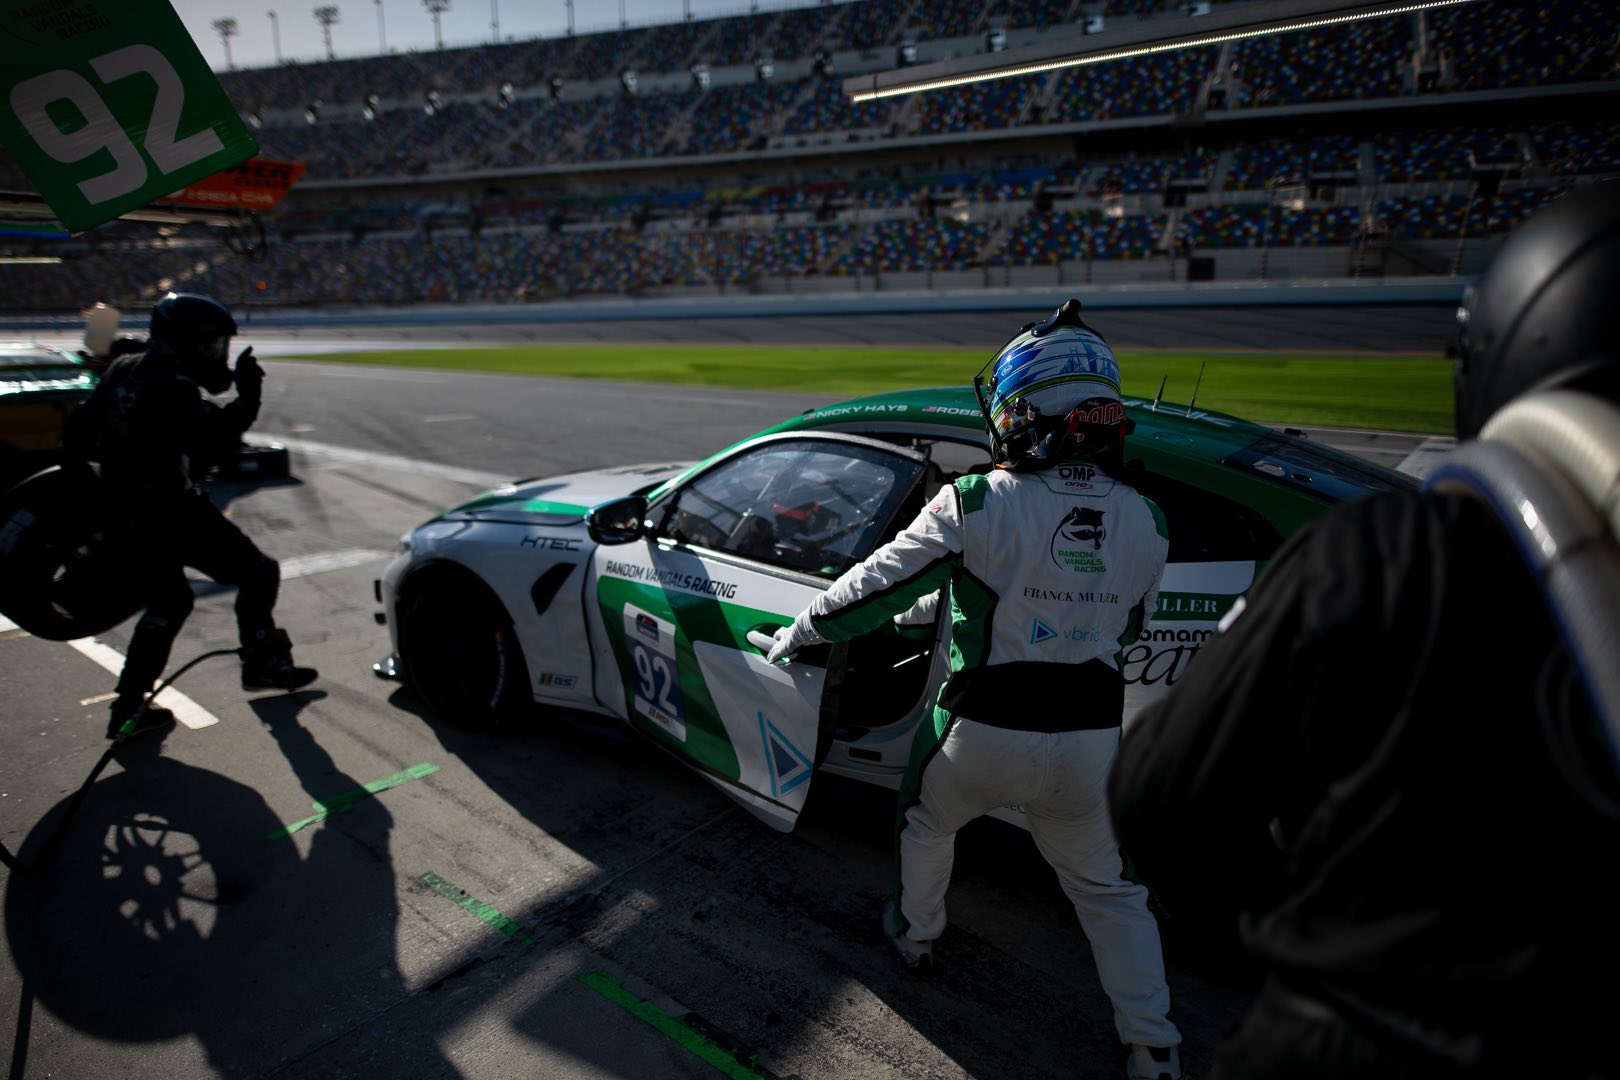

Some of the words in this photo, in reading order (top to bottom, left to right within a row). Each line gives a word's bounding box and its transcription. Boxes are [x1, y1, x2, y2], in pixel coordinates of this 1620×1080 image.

[9, 44, 225, 206] 92
[816, 405, 863, 419] NICKY
[864, 404, 909, 413] HAYS
[1059, 466, 1095, 481] OMP
[520, 536, 583, 551] HTEC
[1058, 550, 1093, 558] RANDOM
[1064, 558, 1103, 566] VANDALS
[606, 560, 644, 580] RANDOM
[645, 568, 691, 590] VANDALS
[691, 577, 737, 598] RACING
[1023, 587, 1073, 602] FRANCK
[634, 645, 677, 716] 92
